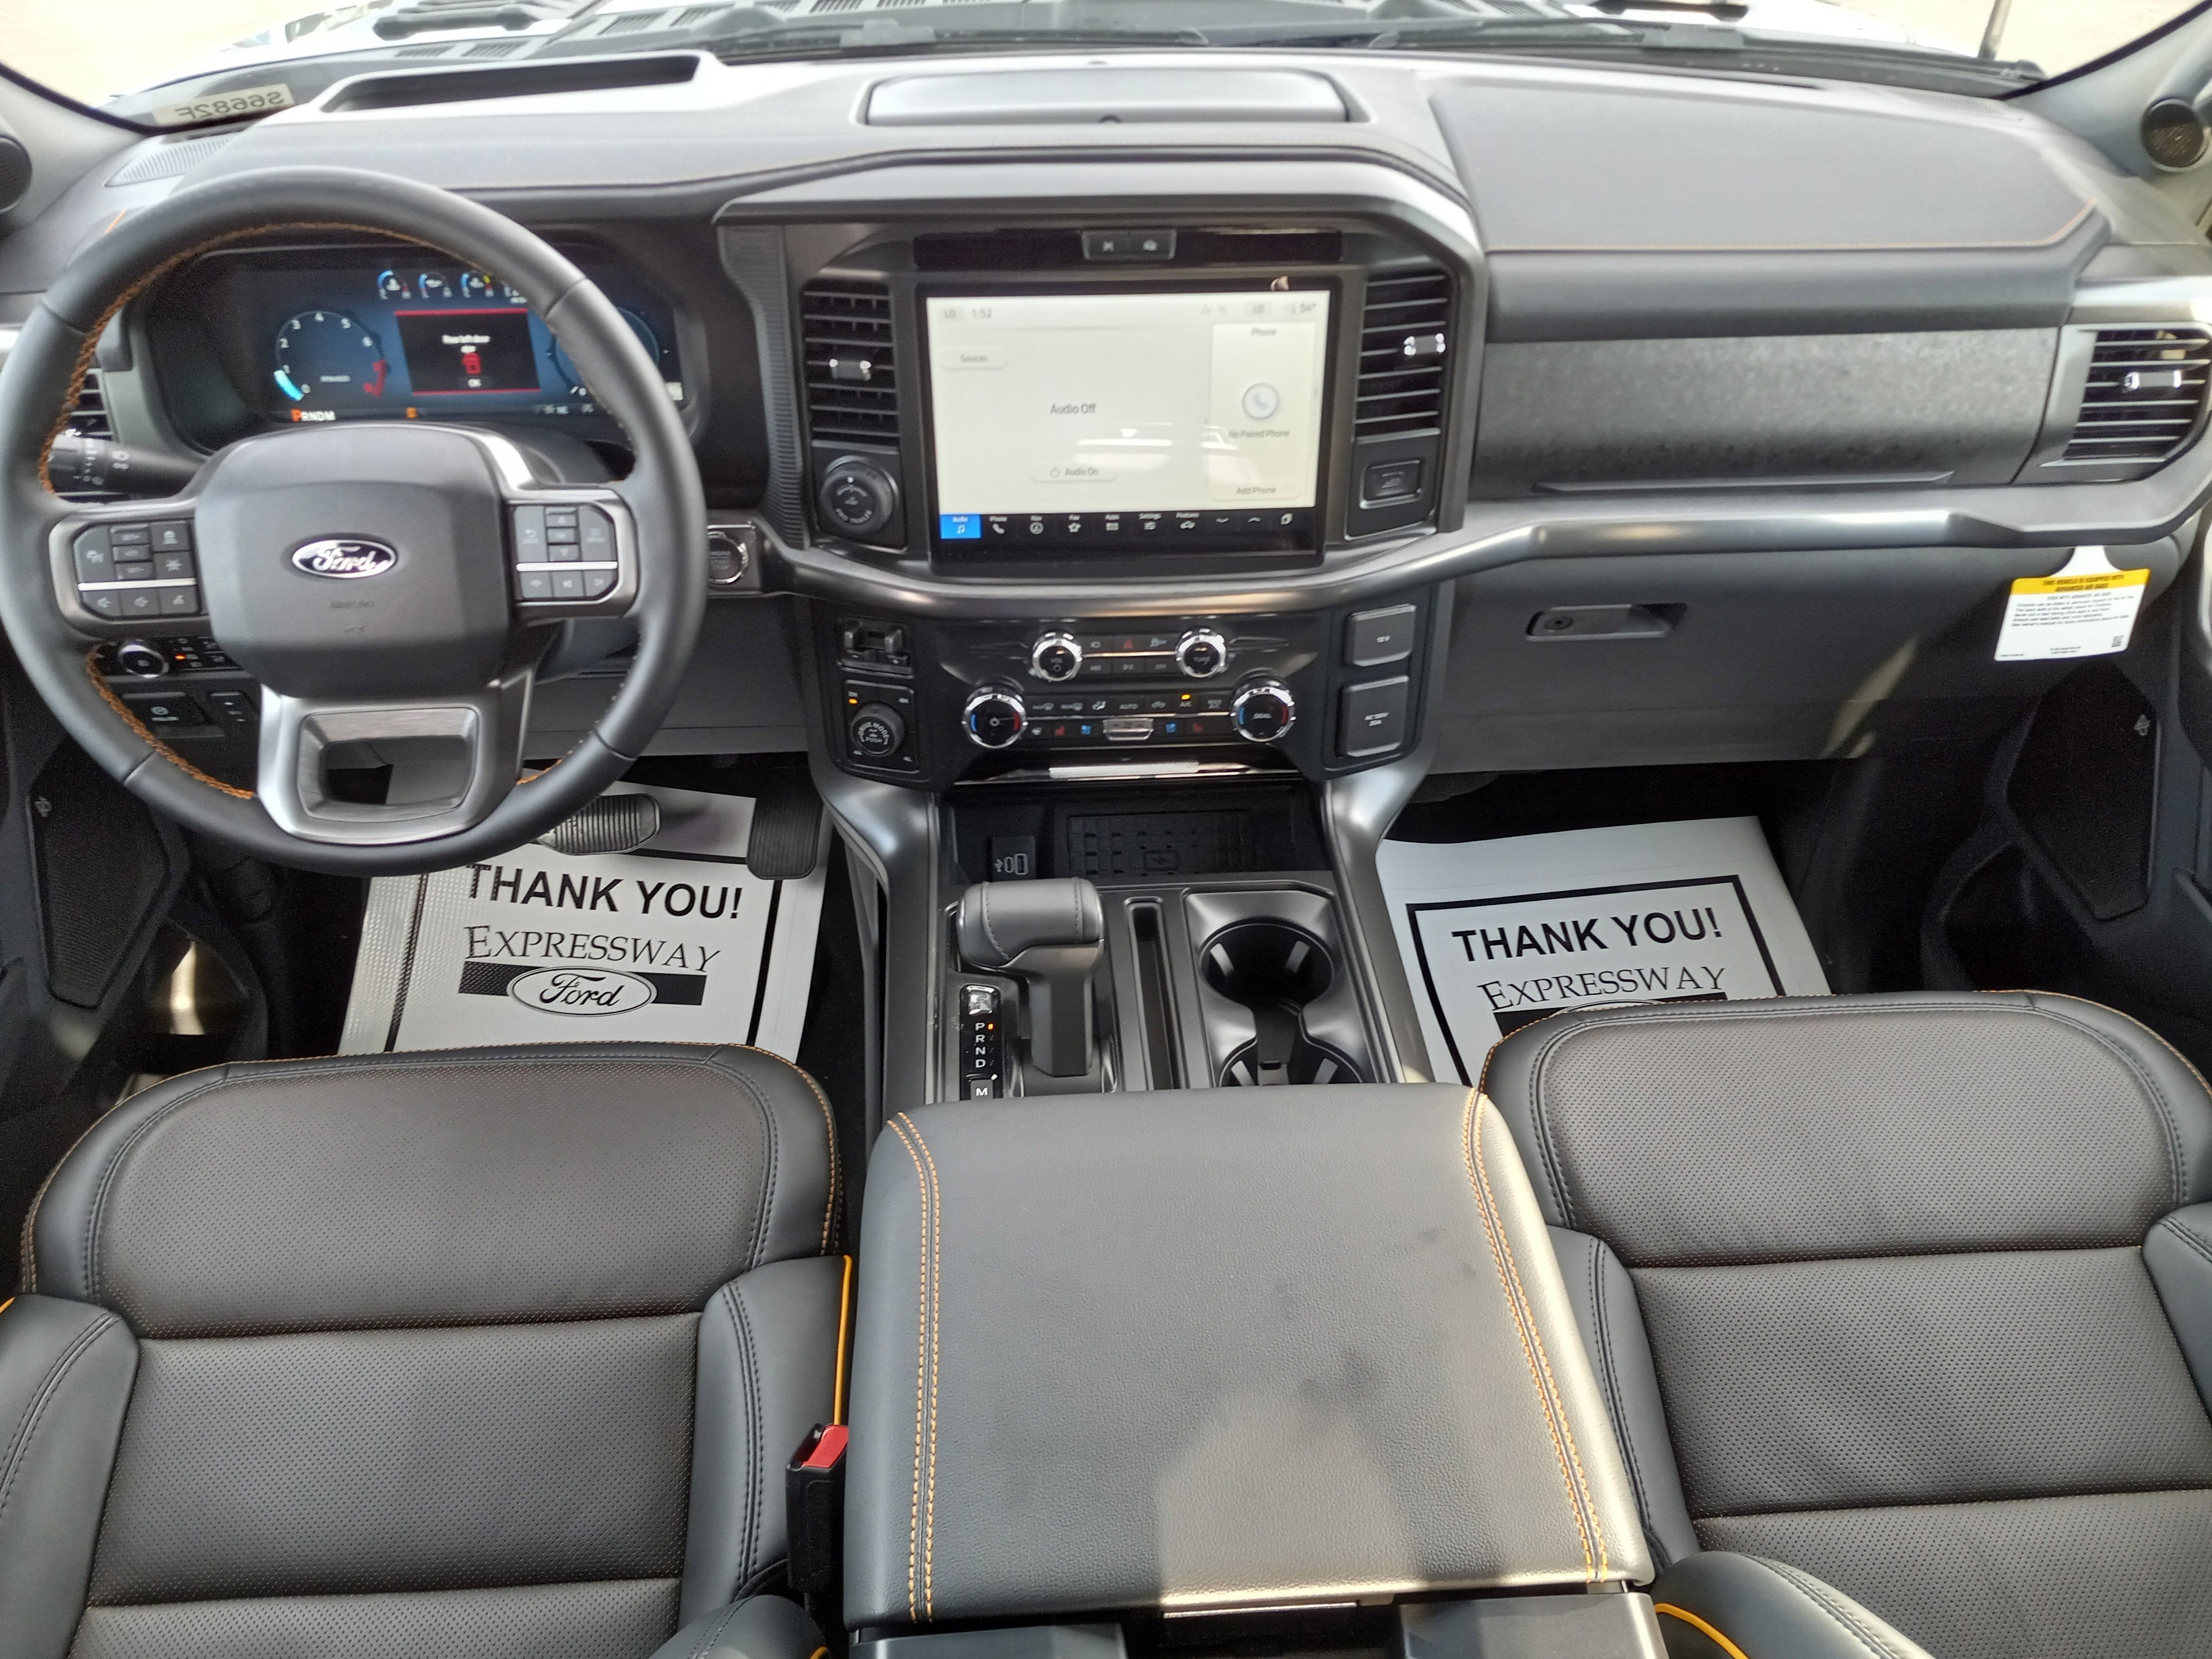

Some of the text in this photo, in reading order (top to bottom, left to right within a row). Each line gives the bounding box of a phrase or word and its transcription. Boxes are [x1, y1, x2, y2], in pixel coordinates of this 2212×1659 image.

[1050, 402, 1096, 414] Audio Off
[1265, 429, 1290, 438] Phone
[1065, 467, 1099, 476] Audio On
[312, 544, 391, 571] Ford
[465, 864, 743, 919] THANK YOU!
[1451, 906, 1723, 962] THANK YOU!
[539, 969, 623, 1008] Ford
[975, 1022, 986, 1031] P
[975, 1034, 986, 1043] R
[975, 1046, 986, 1055] N
[975, 1058, 986, 1068] D
[975, 1087, 988, 1097] M
